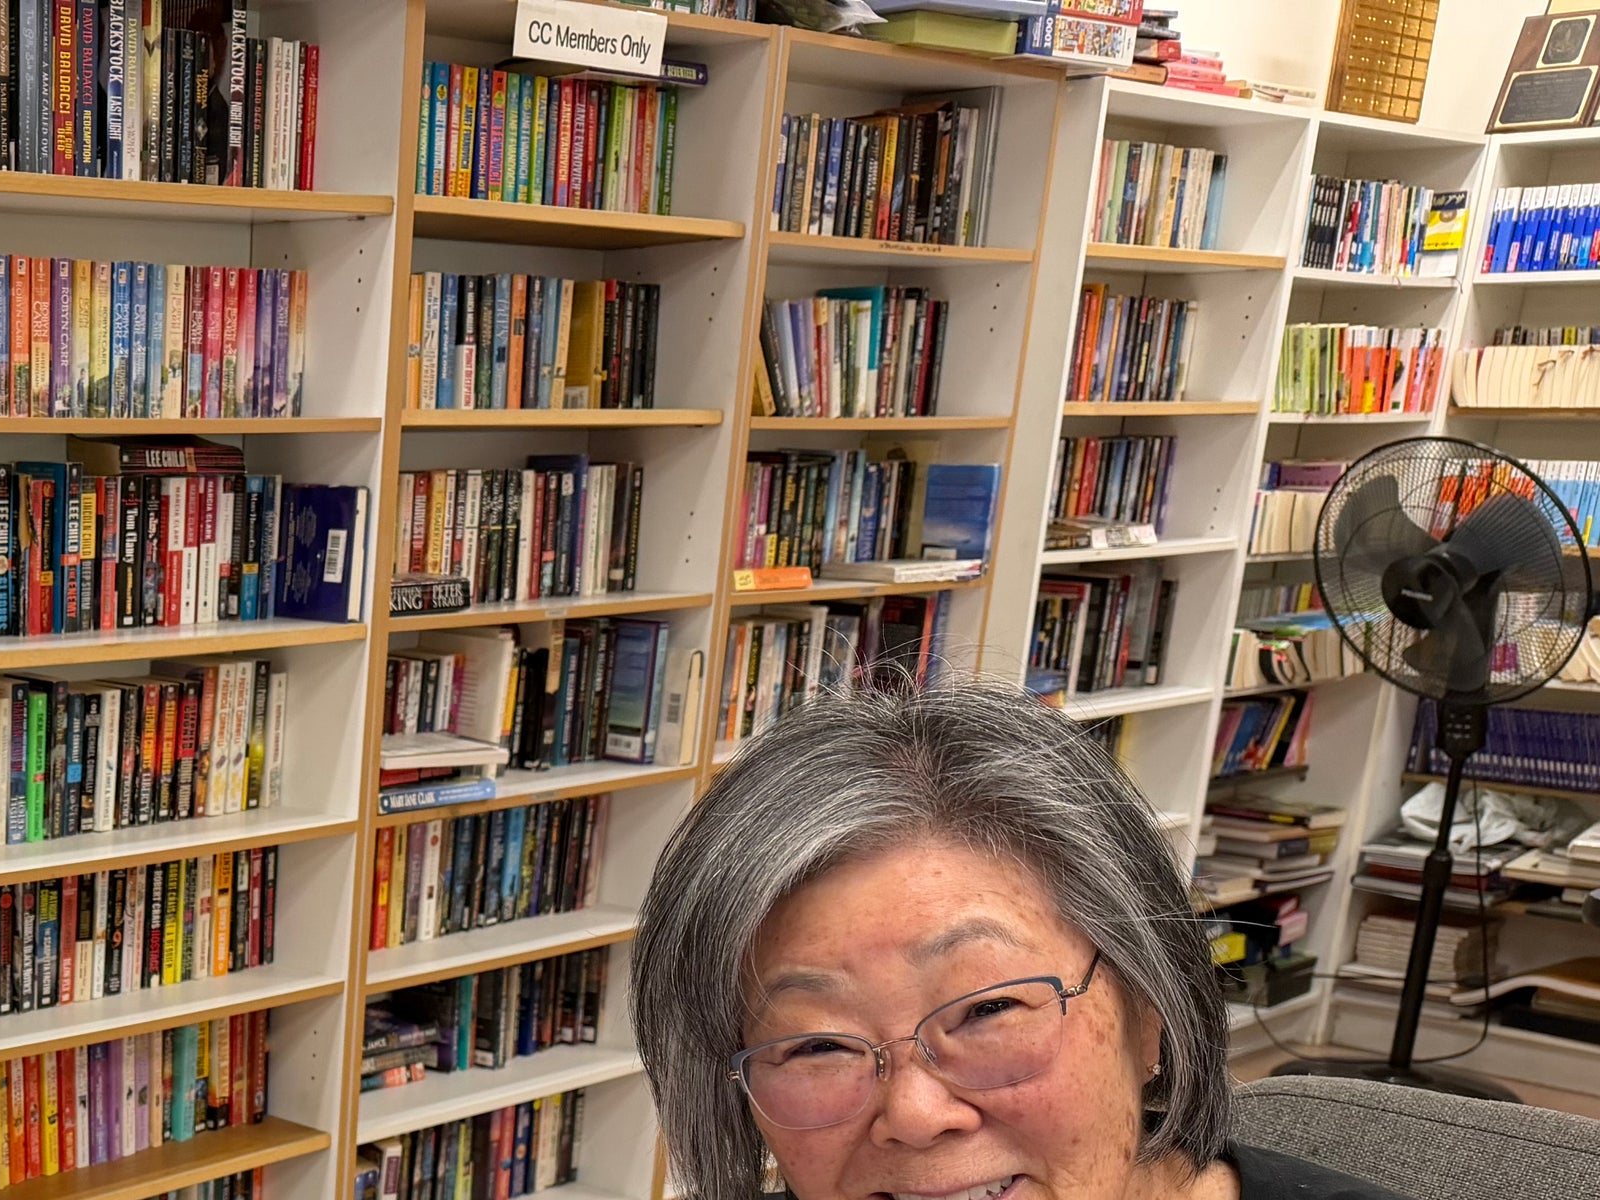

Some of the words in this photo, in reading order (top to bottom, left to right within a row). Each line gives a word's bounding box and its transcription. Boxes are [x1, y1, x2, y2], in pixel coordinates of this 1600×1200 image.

[59, 6, 71, 46] DAVID
[82, 8, 93, 44] DAVID
[128, 17, 138, 53] DAVID
[528, 20, 552, 45] CC
[555, 24, 617, 54] Members
[621, 34, 651, 64] Only
[1043, 16, 1055, 49] 1000
[230, 9, 246, 93] BLACKSTOCK
[59, 51, 71, 114] BALDACCI
[82, 47, 93, 104] BALDACCI
[127, 56, 137, 110] BALDACCI
[0, 82, 8, 113] ISABEL
[110, 95, 122, 116] LAST
[166, 71, 174, 121] NEVADA
[229, 101, 242, 124] NIGHT
[109, 118, 122, 140] LIGHT
[575, 103, 585, 132] JANET
[0, 116, 8, 158] ALLENDE
[82, 110, 91, 163] REDEMPTION
[165, 125, 173, 160] BARR
[229, 126, 242, 148] LIGHT
[479, 131, 487, 174] EVANOVICH
[573, 135, 585, 189] EVANOVICH
[478, 176, 486, 191] HOT
[33, 301, 42, 338] CARR
[60, 287, 69, 330] ROBYN
[60, 334, 68, 367] CARR
[464, 370, 472, 406] DECEPTION
[146, 449, 161, 467] LEE
[162, 450, 185, 468] CHILD
[69, 500, 79, 519] LEE
[205, 481, 214, 510] MARCIA
[83, 497, 92, 534] LINCOLN
[126, 509, 138, 528] Tom
[205, 513, 213, 540] CLARK
[455, 504, 463, 539] GRAFTON
[68, 521, 79, 552] CHILD
[82, 537, 92, 556] CHILD
[123, 532, 137, 563] Clancy
[67, 582, 76, 618] ENEMY
[81, 582, 91, 610] STORM
[432, 584, 463, 598] PETER
[432, 596, 464, 610] STRAUB
[87, 727, 97, 755] MICHAEL
[86, 758, 95, 794] CONNELLY
[140, 773, 152, 812] LIBERTY
[123, 774, 132, 818] TRAITOR
[152, 870, 163, 901] ROBERT
[151, 903, 161, 929] CRAIS
[149, 930, 161, 972] HOSTAGE
